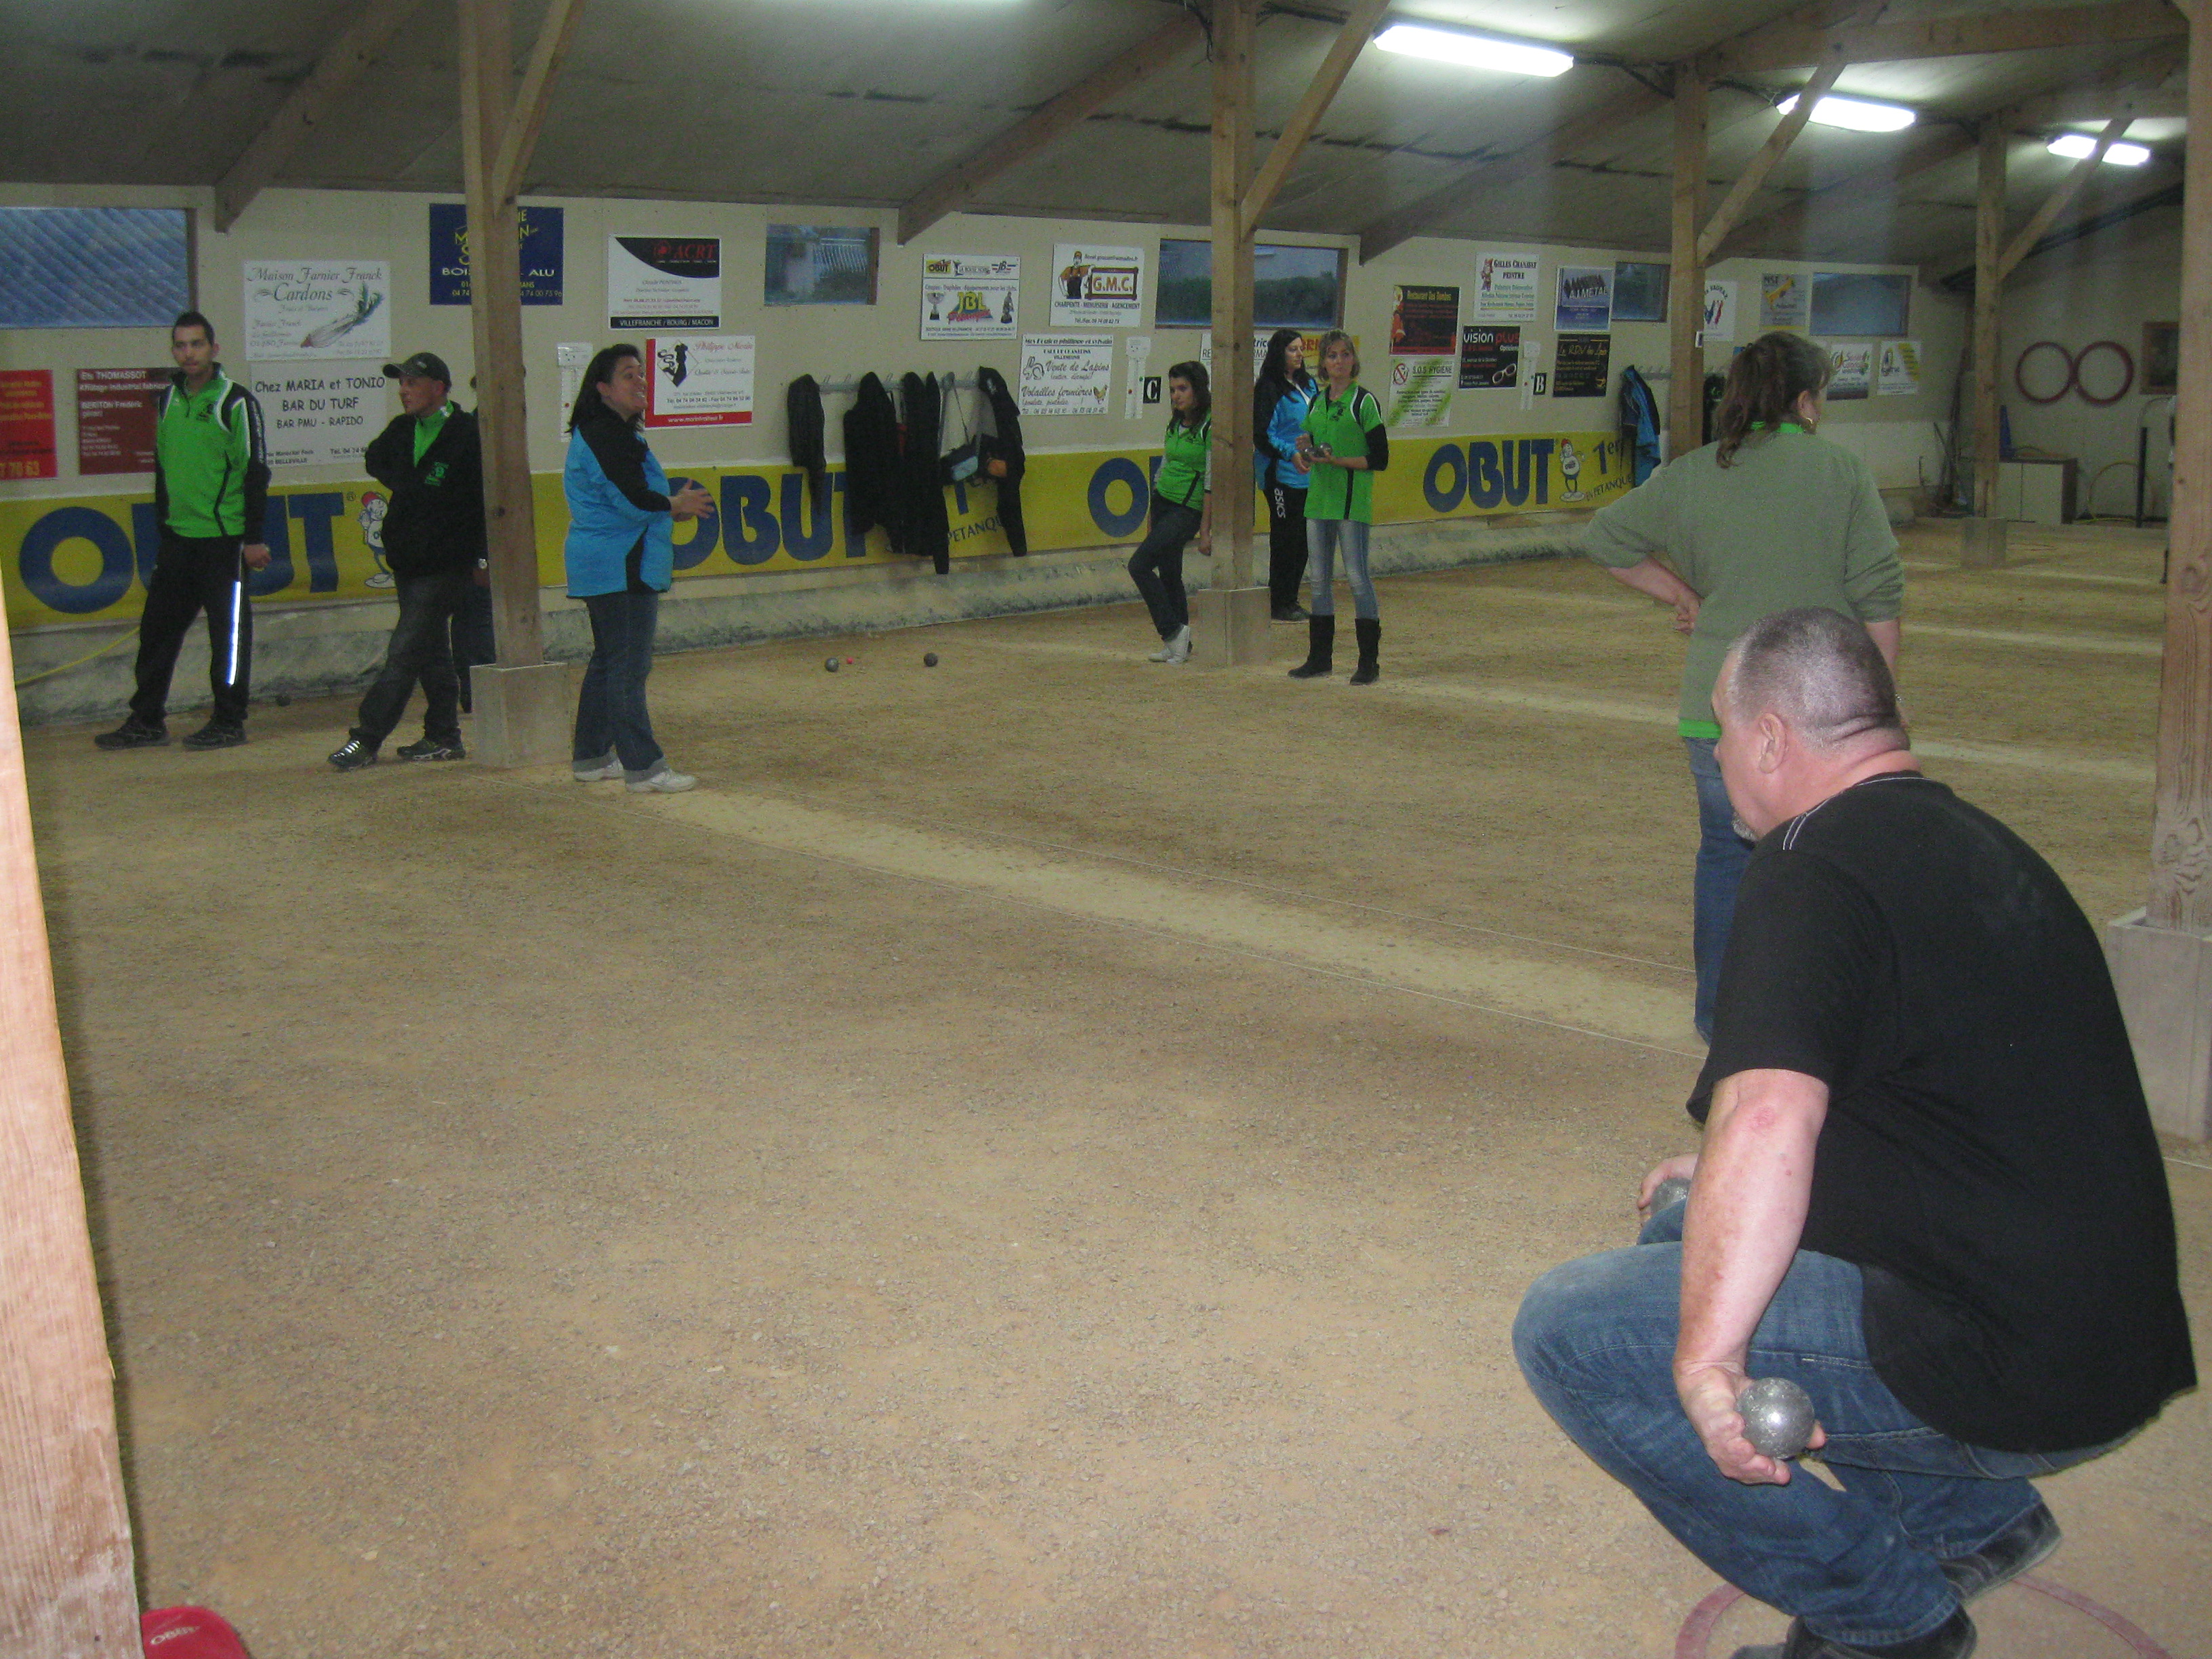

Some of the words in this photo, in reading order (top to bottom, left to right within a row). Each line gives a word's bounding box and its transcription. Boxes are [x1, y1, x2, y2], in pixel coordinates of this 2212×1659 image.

[247, 267, 293, 282] Maison
[342, 267, 382, 283] Franck
[529, 269, 555, 277] ALU
[273, 282, 333, 302] Cardons
[958, 291, 987, 314] JBL
[1463, 328, 1494, 344] vision
[1046, 360, 1067, 372] Vente
[1069, 361, 1080, 371] de
[1080, 359, 1110, 372] Lapins
[255, 380, 281, 393] Chez
[285, 378, 325, 392] MARIA
[329, 379, 342, 390] et
[346, 376, 386, 389] TONIO
[1021, 385, 1056, 397] Volailles
[1146, 380, 1158, 401] C
[1536, 375, 1544, 392] B
[282, 399, 306, 412] BAR
[309, 398, 326, 411] DU
[329, 396, 360, 410] TURF
[276, 419, 295, 429] BAR
[298, 417, 317, 428] PMU
[329, 415, 364, 427] RAPIDO
[1423, 438, 1555, 513] OBUT
[1273, 487, 1286, 519] asics
